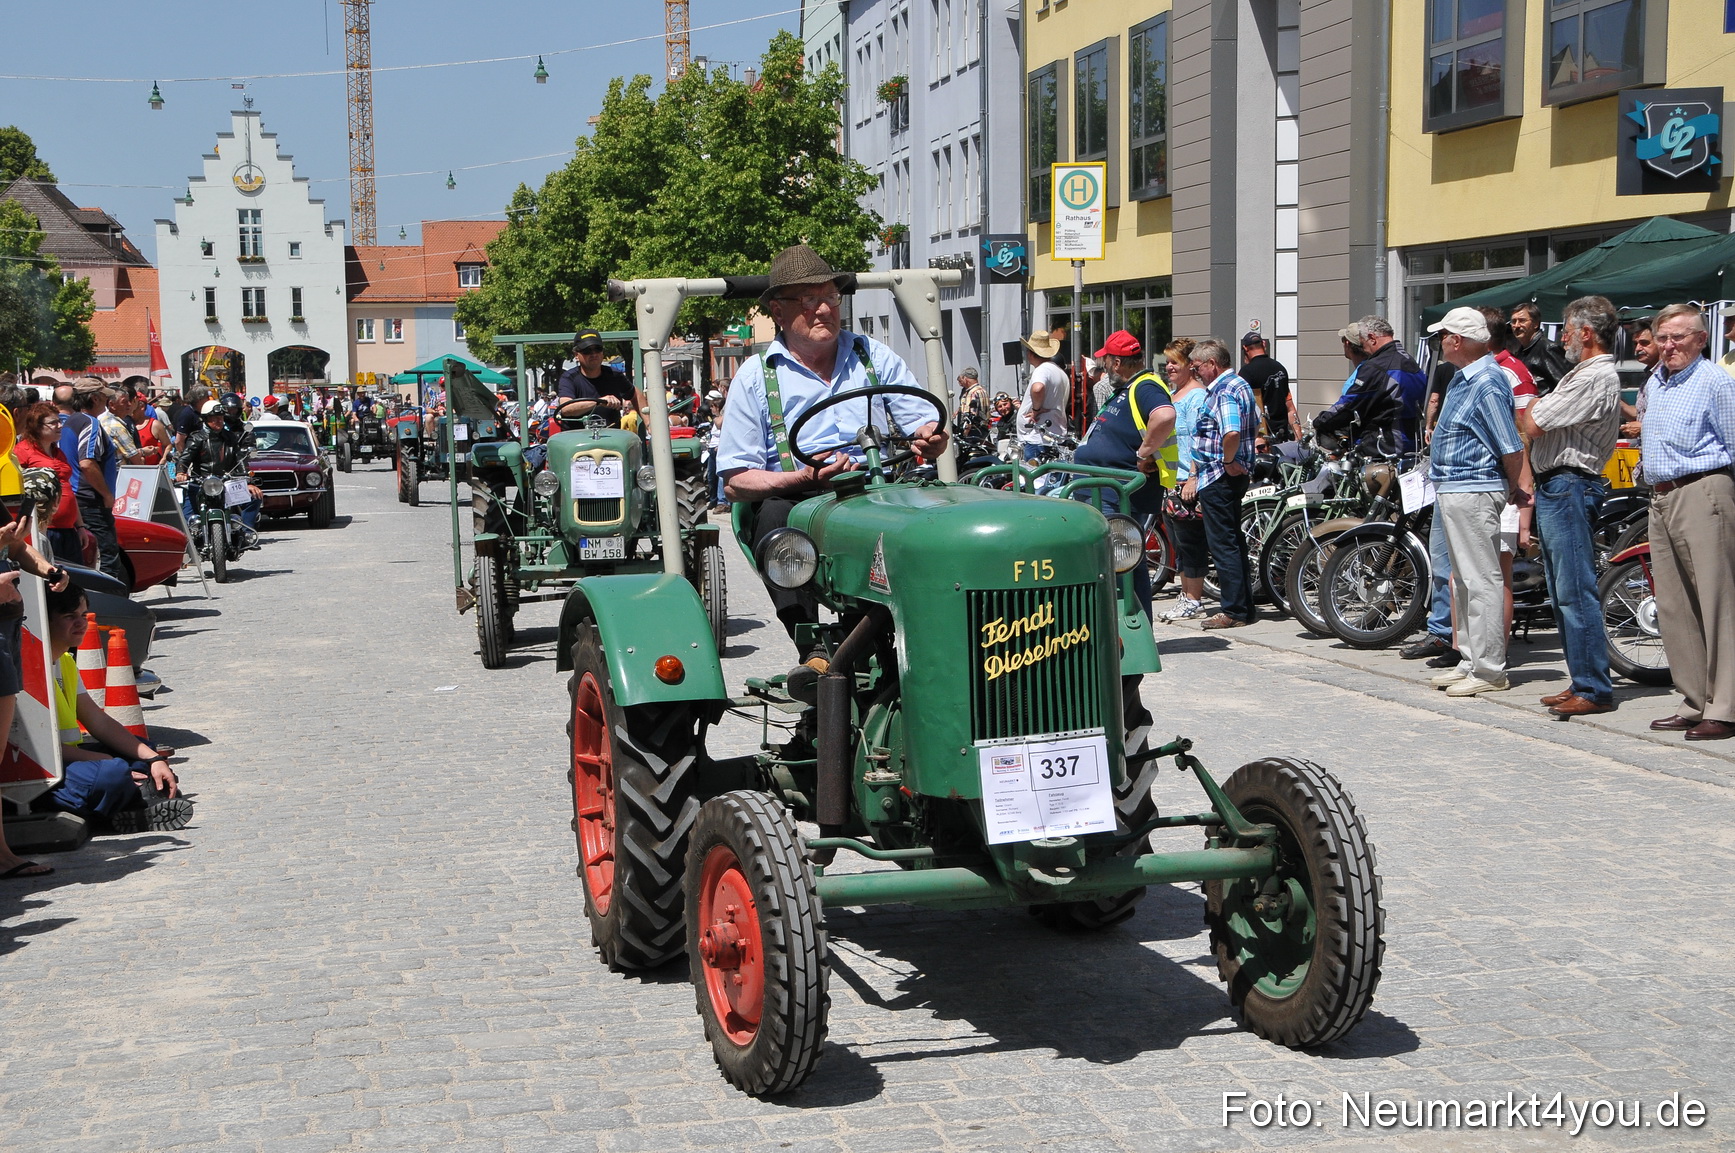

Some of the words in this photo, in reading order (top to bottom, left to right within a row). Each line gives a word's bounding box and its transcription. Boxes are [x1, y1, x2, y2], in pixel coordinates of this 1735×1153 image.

[1660, 117, 1696, 160] G2
[1070, 179, 1087, 202] H
[997, 247, 1014, 268] G2
[593, 467, 612, 476] 433
[1259, 487, 1272, 495] 102
[584, 550, 598, 559] BW
[602, 549, 622, 558] 158
[588, 539, 601, 548] NM
[1013, 561, 1026, 582] F
[1031, 559, 1055, 581] 15
[981, 601, 1055, 648] Fendt
[984, 624, 1090, 681] Dieselross
[1040, 755, 1080, 780] 337
